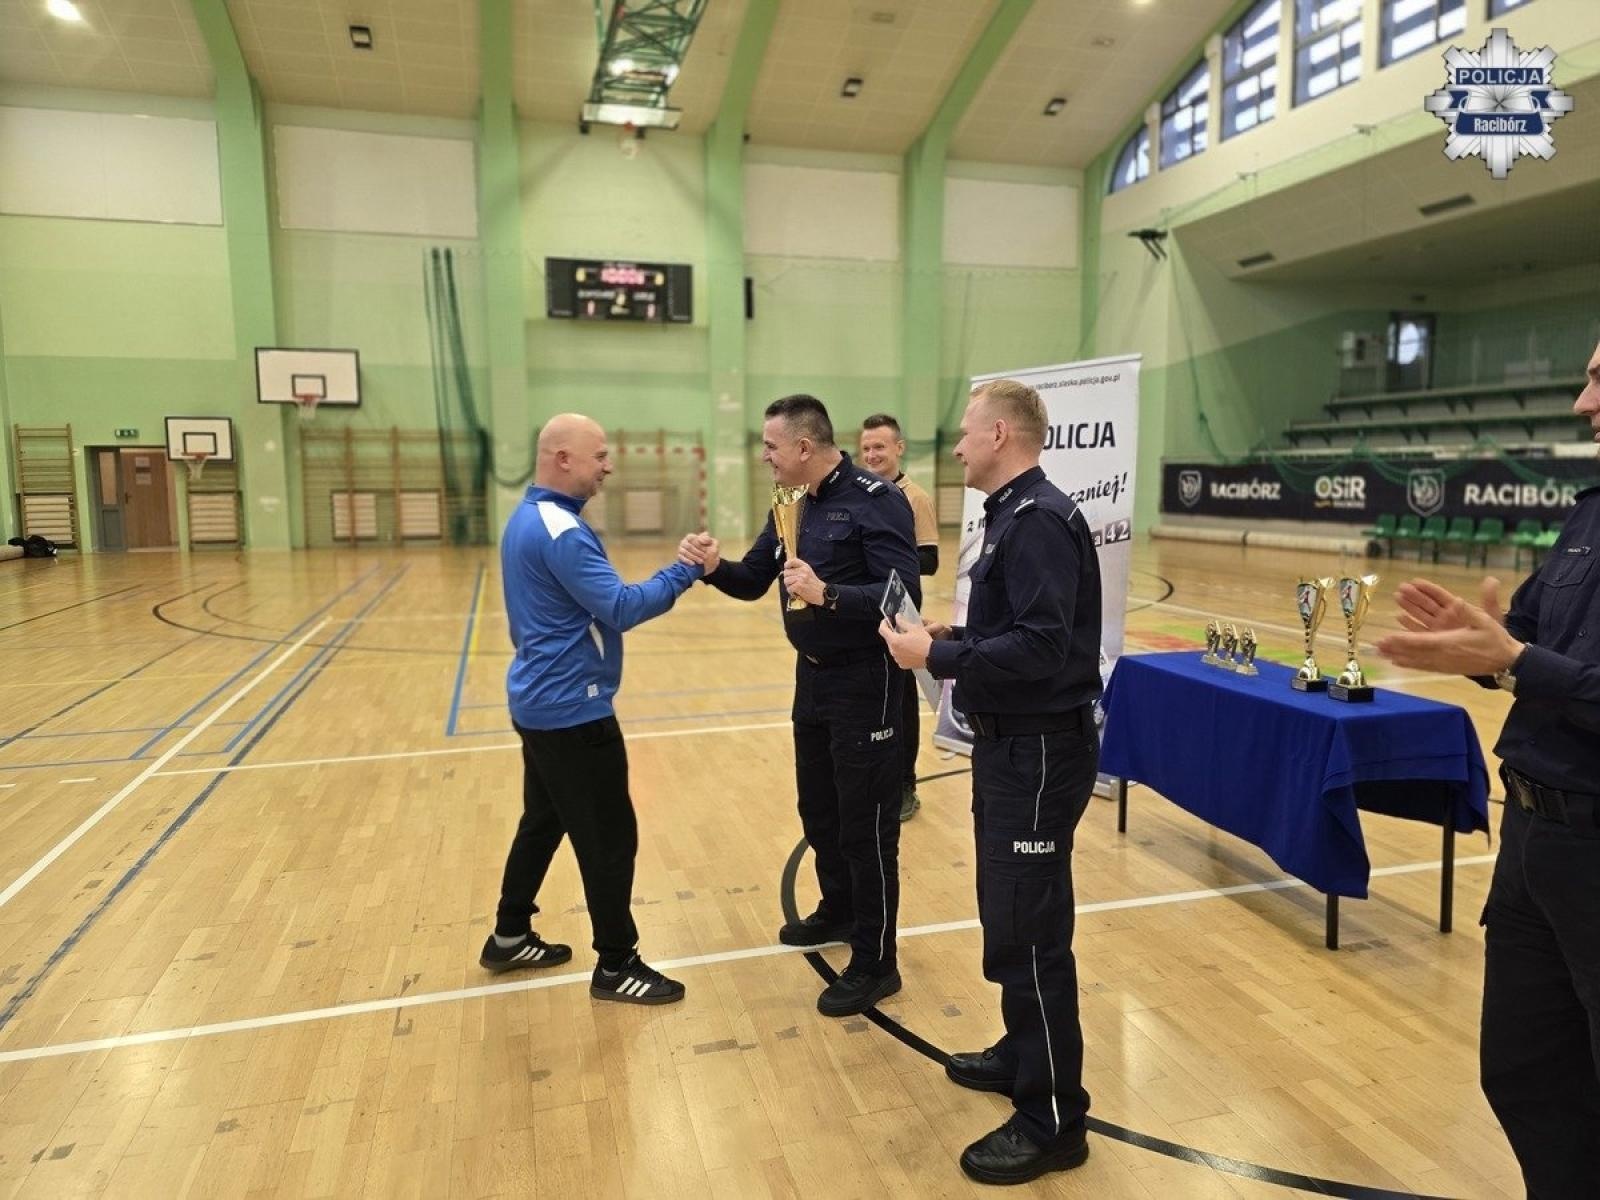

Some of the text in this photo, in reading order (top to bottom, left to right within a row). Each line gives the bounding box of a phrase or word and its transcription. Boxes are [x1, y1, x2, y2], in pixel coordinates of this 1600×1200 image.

[1043, 421, 1116, 450] OLICJA
[1463, 477, 1583, 508] RACIBÓR
[1012, 840, 1056, 854] POLICJA
